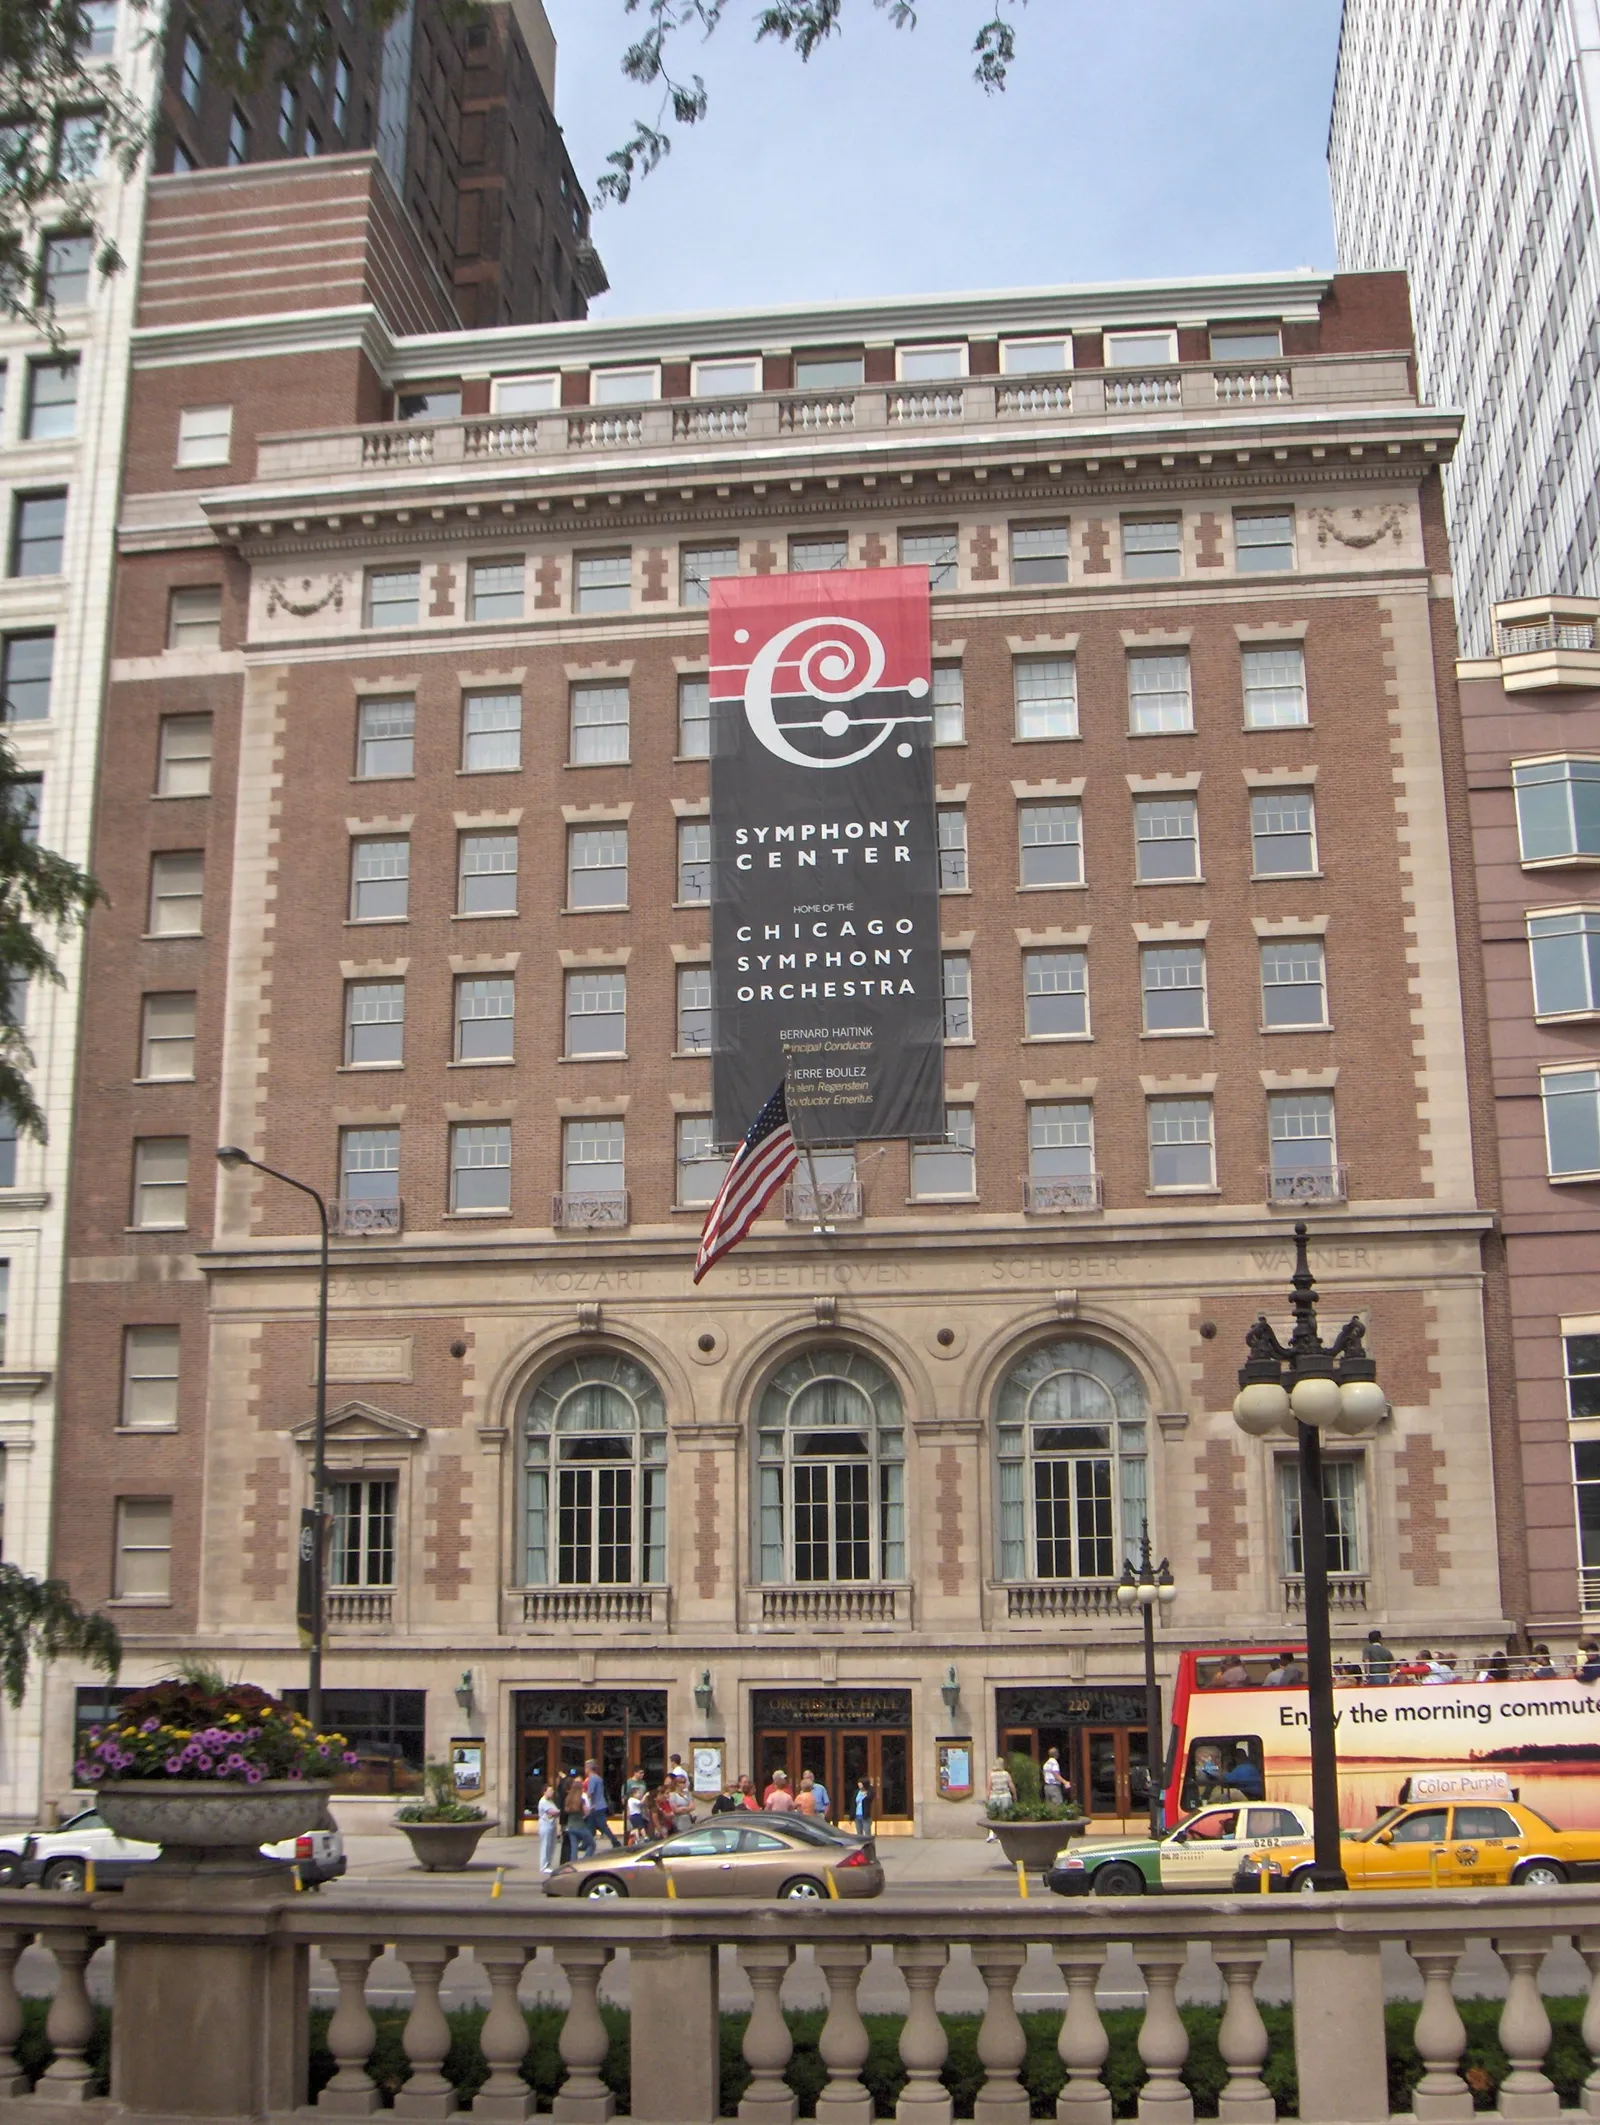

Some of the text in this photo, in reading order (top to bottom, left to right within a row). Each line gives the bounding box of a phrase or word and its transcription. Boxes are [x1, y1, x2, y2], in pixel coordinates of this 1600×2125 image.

[735, 820, 911, 845] SYMPHONY
[736, 846, 911, 870] CENTER
[793, 902, 855, 914] HOME OF THE
[736, 918, 914, 942] CHICAGO
[737, 949, 913, 972] SYMPHONY
[737, 979, 916, 1002] ORCHESTRA
[780, 1026, 873, 1040] BERNARD HAITINK
[824, 1040, 873, 1051] Conductor
[787, 1066, 867, 1080] IERRE BOULEZ
[818, 1080, 869, 1093] Regenstein
[833, 1094, 874, 1105] Emeritus
[317, 1276, 401, 1298] BACH
[530, 1270, 649, 1292] MOZART
[737, 1261, 912, 1287] BEETHOVEN
[1250, 1247, 1371, 1271] WANER
[583, 1702, 605, 1714] 220
[769, 1697, 899, 1710] ORCHESTRA HALL
[1068, 1699, 1090, 1711] 220
[1279, 1706, 1343, 1731] Eny
[1349, 1702, 1388, 1723] the
[1395, 1699, 1492, 1724] morning
[1418, 1775, 1504, 1794] Color Purple
